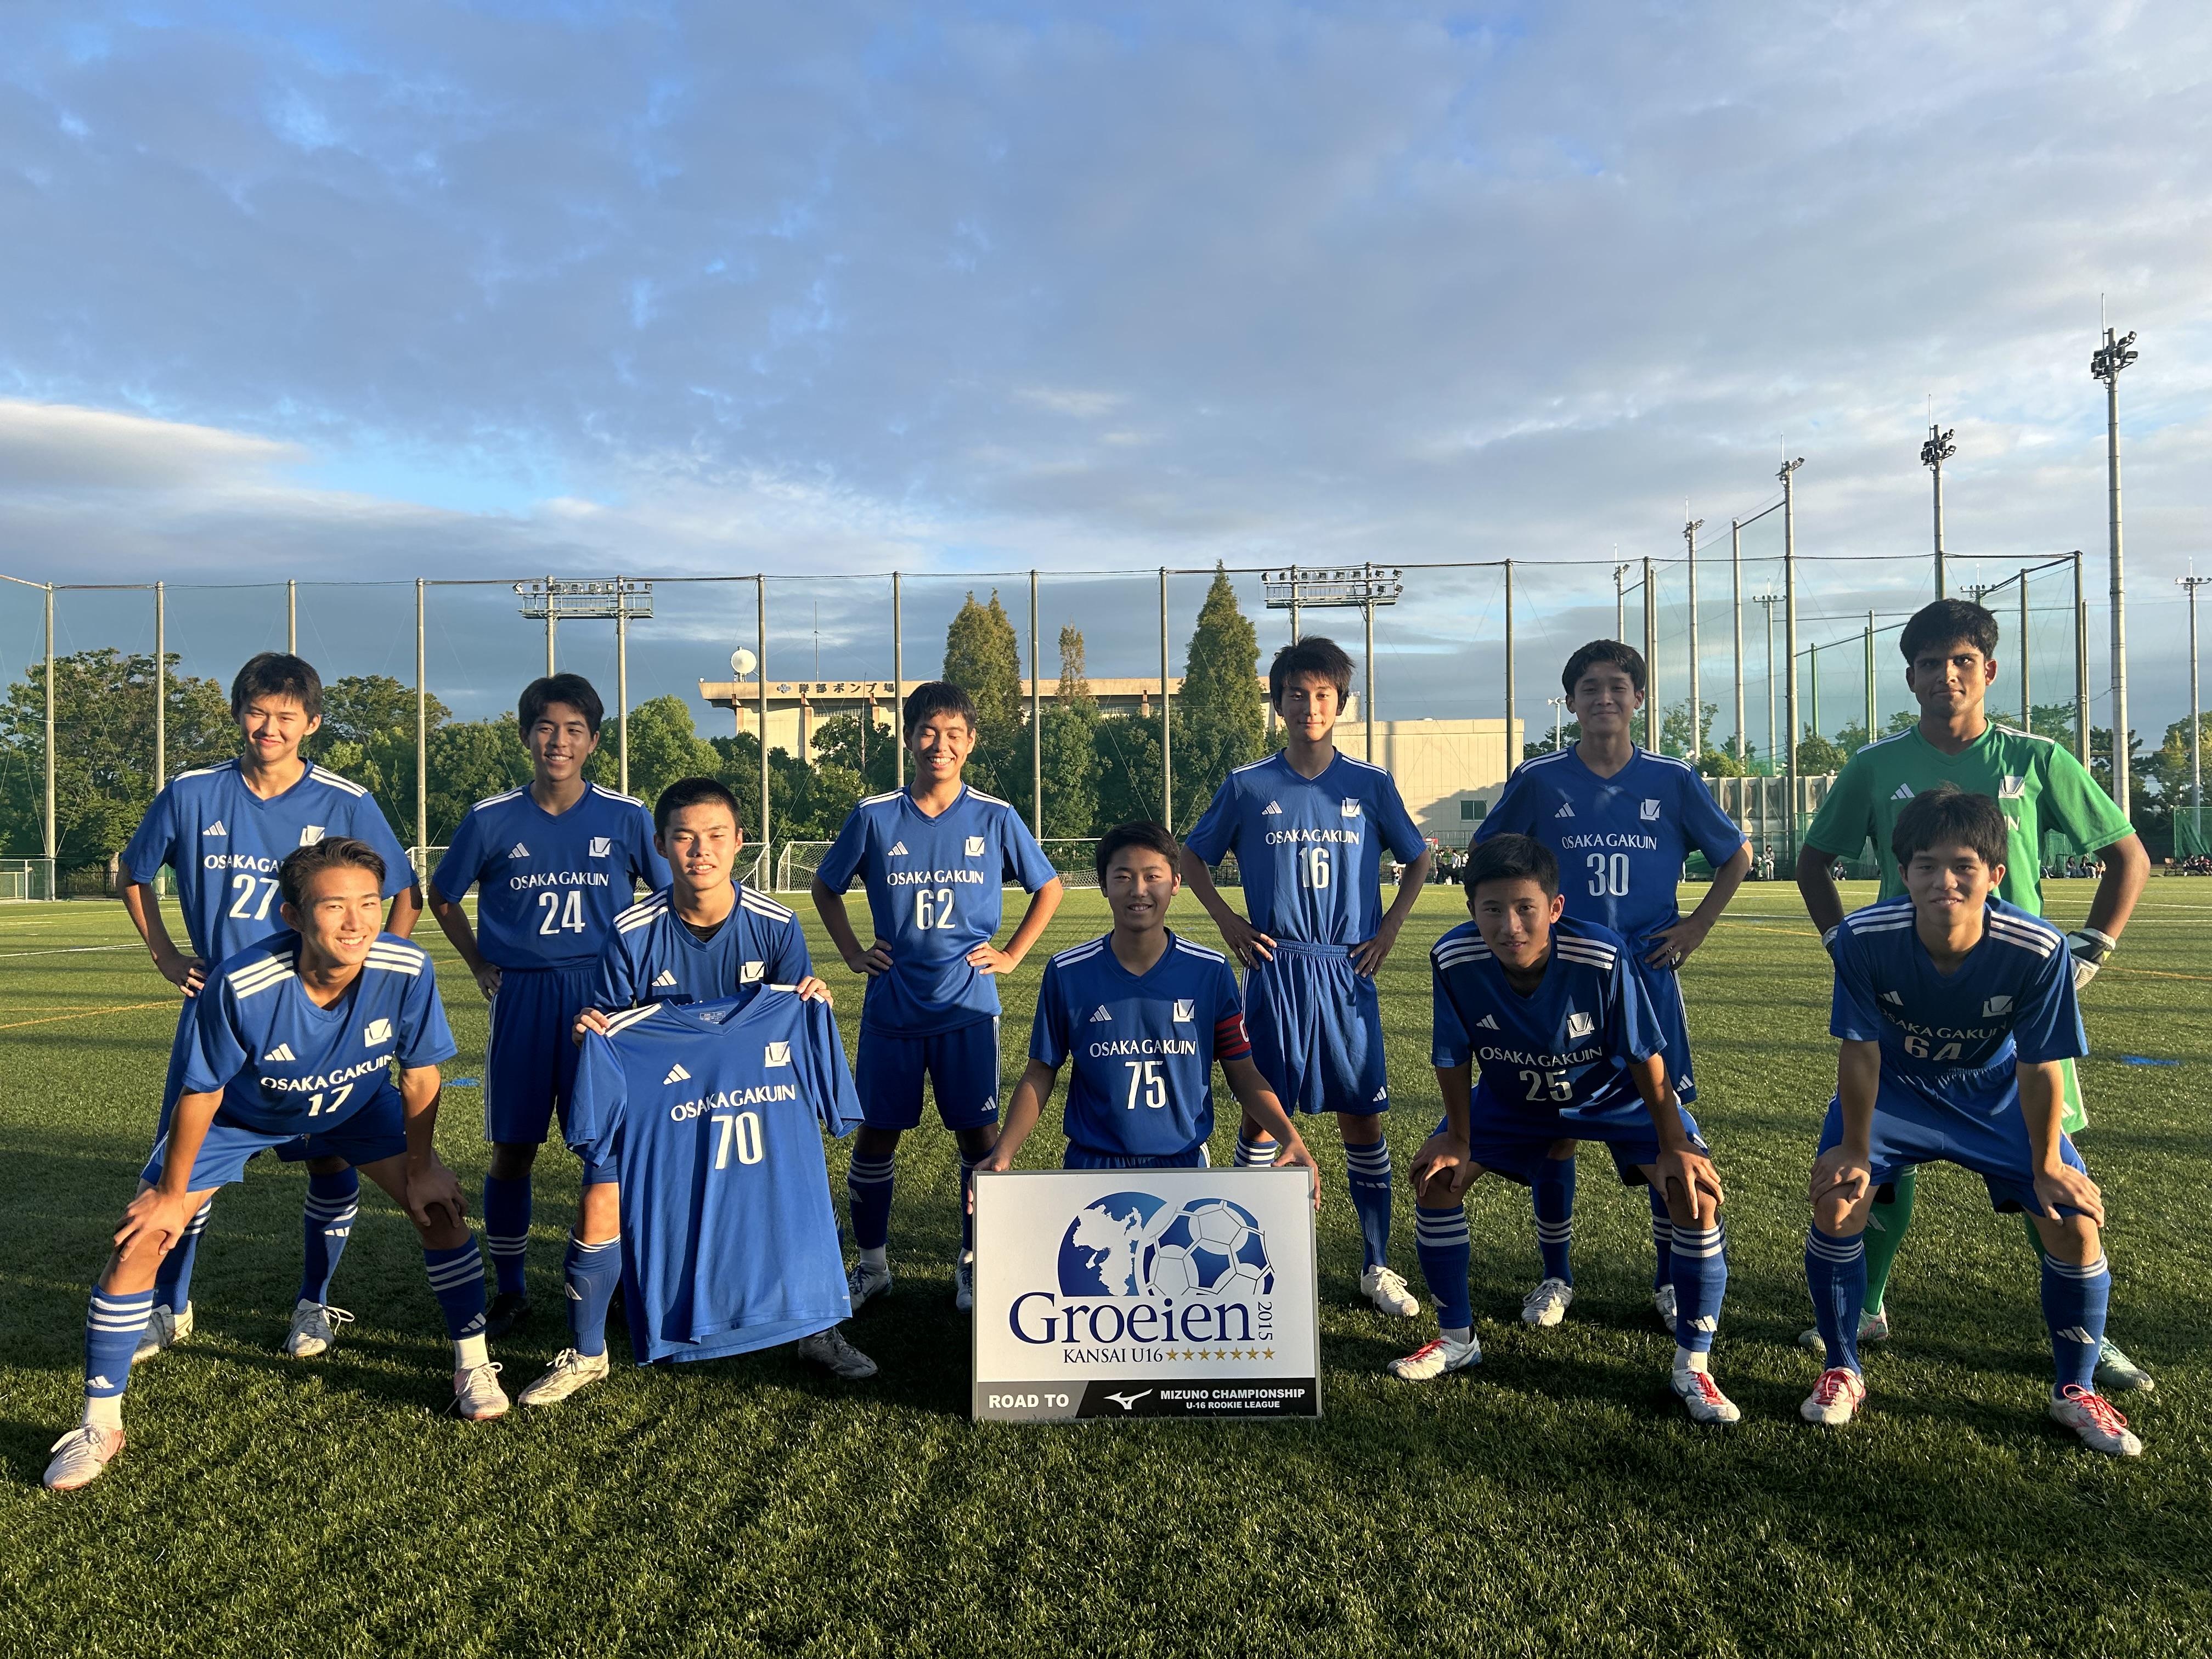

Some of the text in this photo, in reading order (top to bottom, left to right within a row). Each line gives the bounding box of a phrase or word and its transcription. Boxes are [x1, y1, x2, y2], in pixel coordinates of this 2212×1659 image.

[1561, 833, 1657, 850] OSAKA GAKUIN
[510, 871, 610, 890] OSAKA GAKUIN
[887, 870, 984, 885] OSAKA GAKUIN
[1299, 847, 1329, 889] 16
[1587, 853, 1629, 896] 30
[229, 874, 280, 921] 27
[539, 890, 586, 935] 24
[917, 888, 956, 930] 62
[1090, 1039, 1196, 1057] OSAKA GAKUIN
[1480, 1046, 1602, 1066] OSAKA GAKUIN
[1904, 1035, 1962, 1061] 64
[260, 1075, 329, 1091] OSAKA
[308, 1082, 354, 1116] 17
[1125, 1060, 1166, 1109] 75
[1519, 1069, 1573, 1102] 25
[670, 1085, 795, 1121] OSAKA GAKUIN
[711, 1112, 763, 1170] 70
[1009, 1292, 1255, 1344] Groeien
[1257, 1301, 1273, 1341] 2015
[1063, 1347, 1163, 1363] KANSAI U16
[989, 1393, 1069, 1408] ROAD TO
[1160, 1389, 1305, 1400] MIZUNO CHAMPIONSHIP
